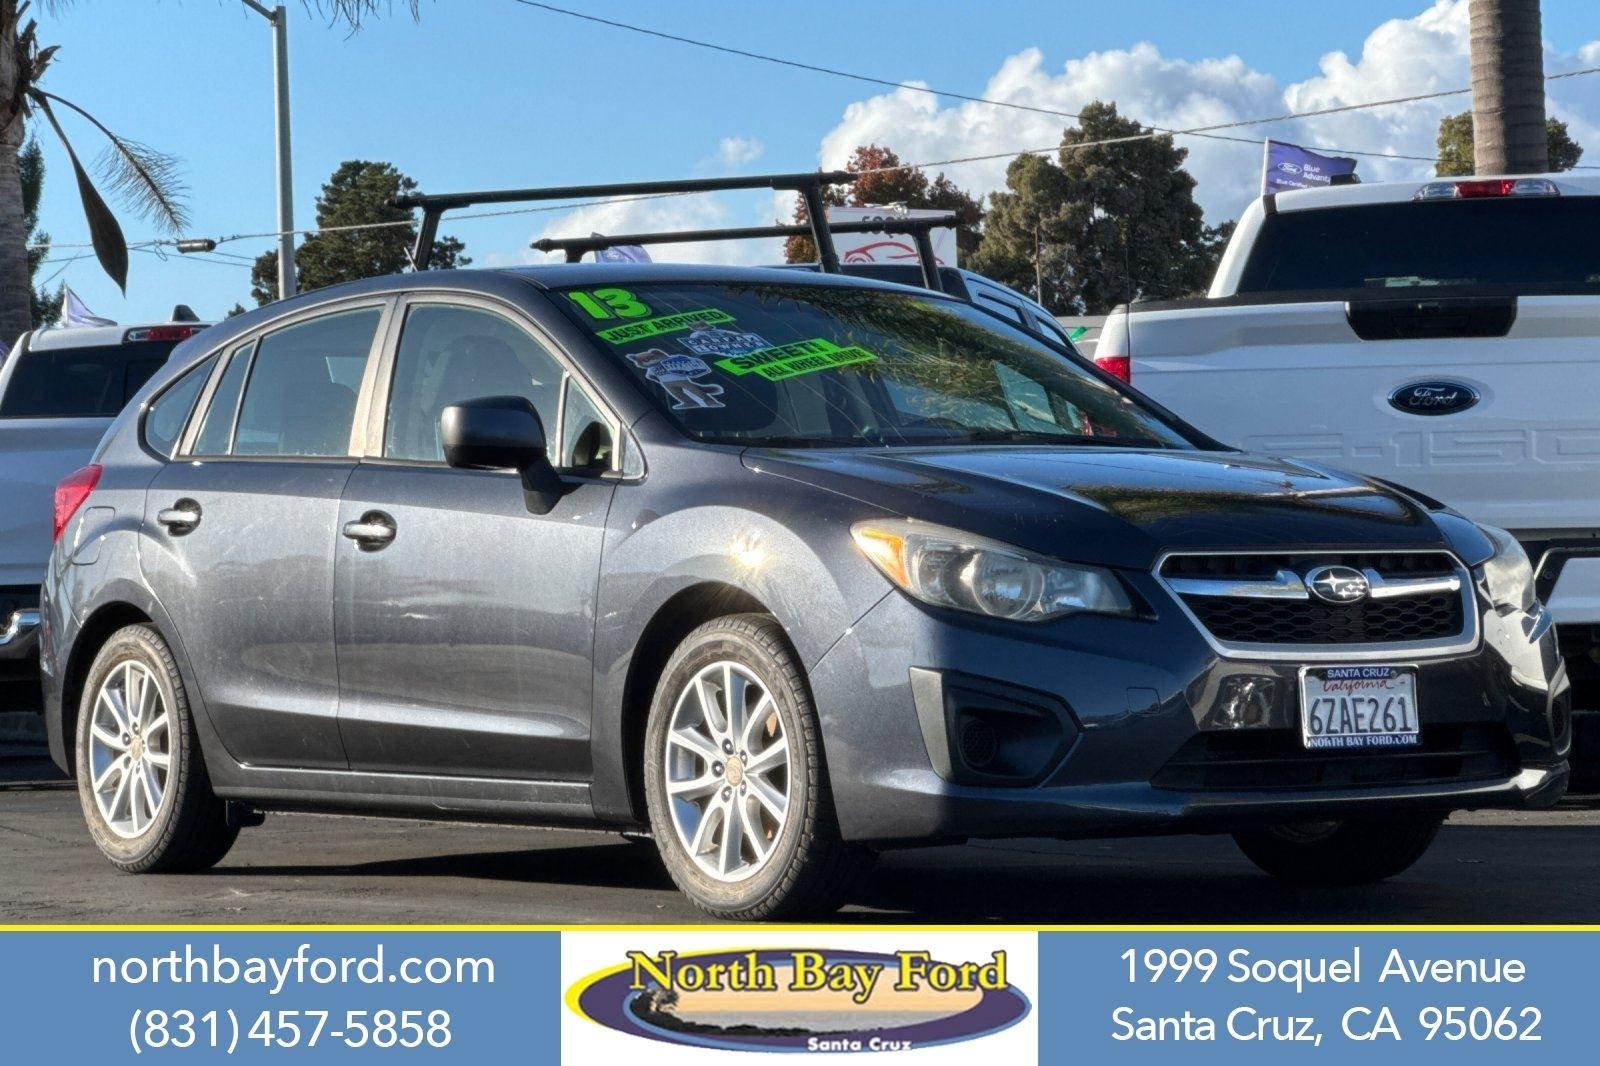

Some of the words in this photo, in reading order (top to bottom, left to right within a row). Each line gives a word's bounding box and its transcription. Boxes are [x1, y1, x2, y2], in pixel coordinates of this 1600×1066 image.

[1303, 164, 1321, 173] Blue
[568, 288, 650, 318] 13
[607, 323, 649, 341] JUST
[651, 311, 725, 331] ARRIVED
[730, 340, 829, 369] SWEET!
[762, 363, 793, 378] ALL
[784, 355, 833, 371] WHEEL
[825, 348, 868, 365] DRIVE
[1409, 386, 1458, 406] Ford
[1327, 668, 1360, 679] SANTA
[1362, 667, 1390, 678] CRUZ
[1323, 680, 1395, 696] California
[1310, 696, 1413, 736] 6ZAE261
[1310, 737, 1344, 748] NORTH
[1346, 736, 1365, 747] BAY
[1367, 734, 1417, 745] FORD.COM
